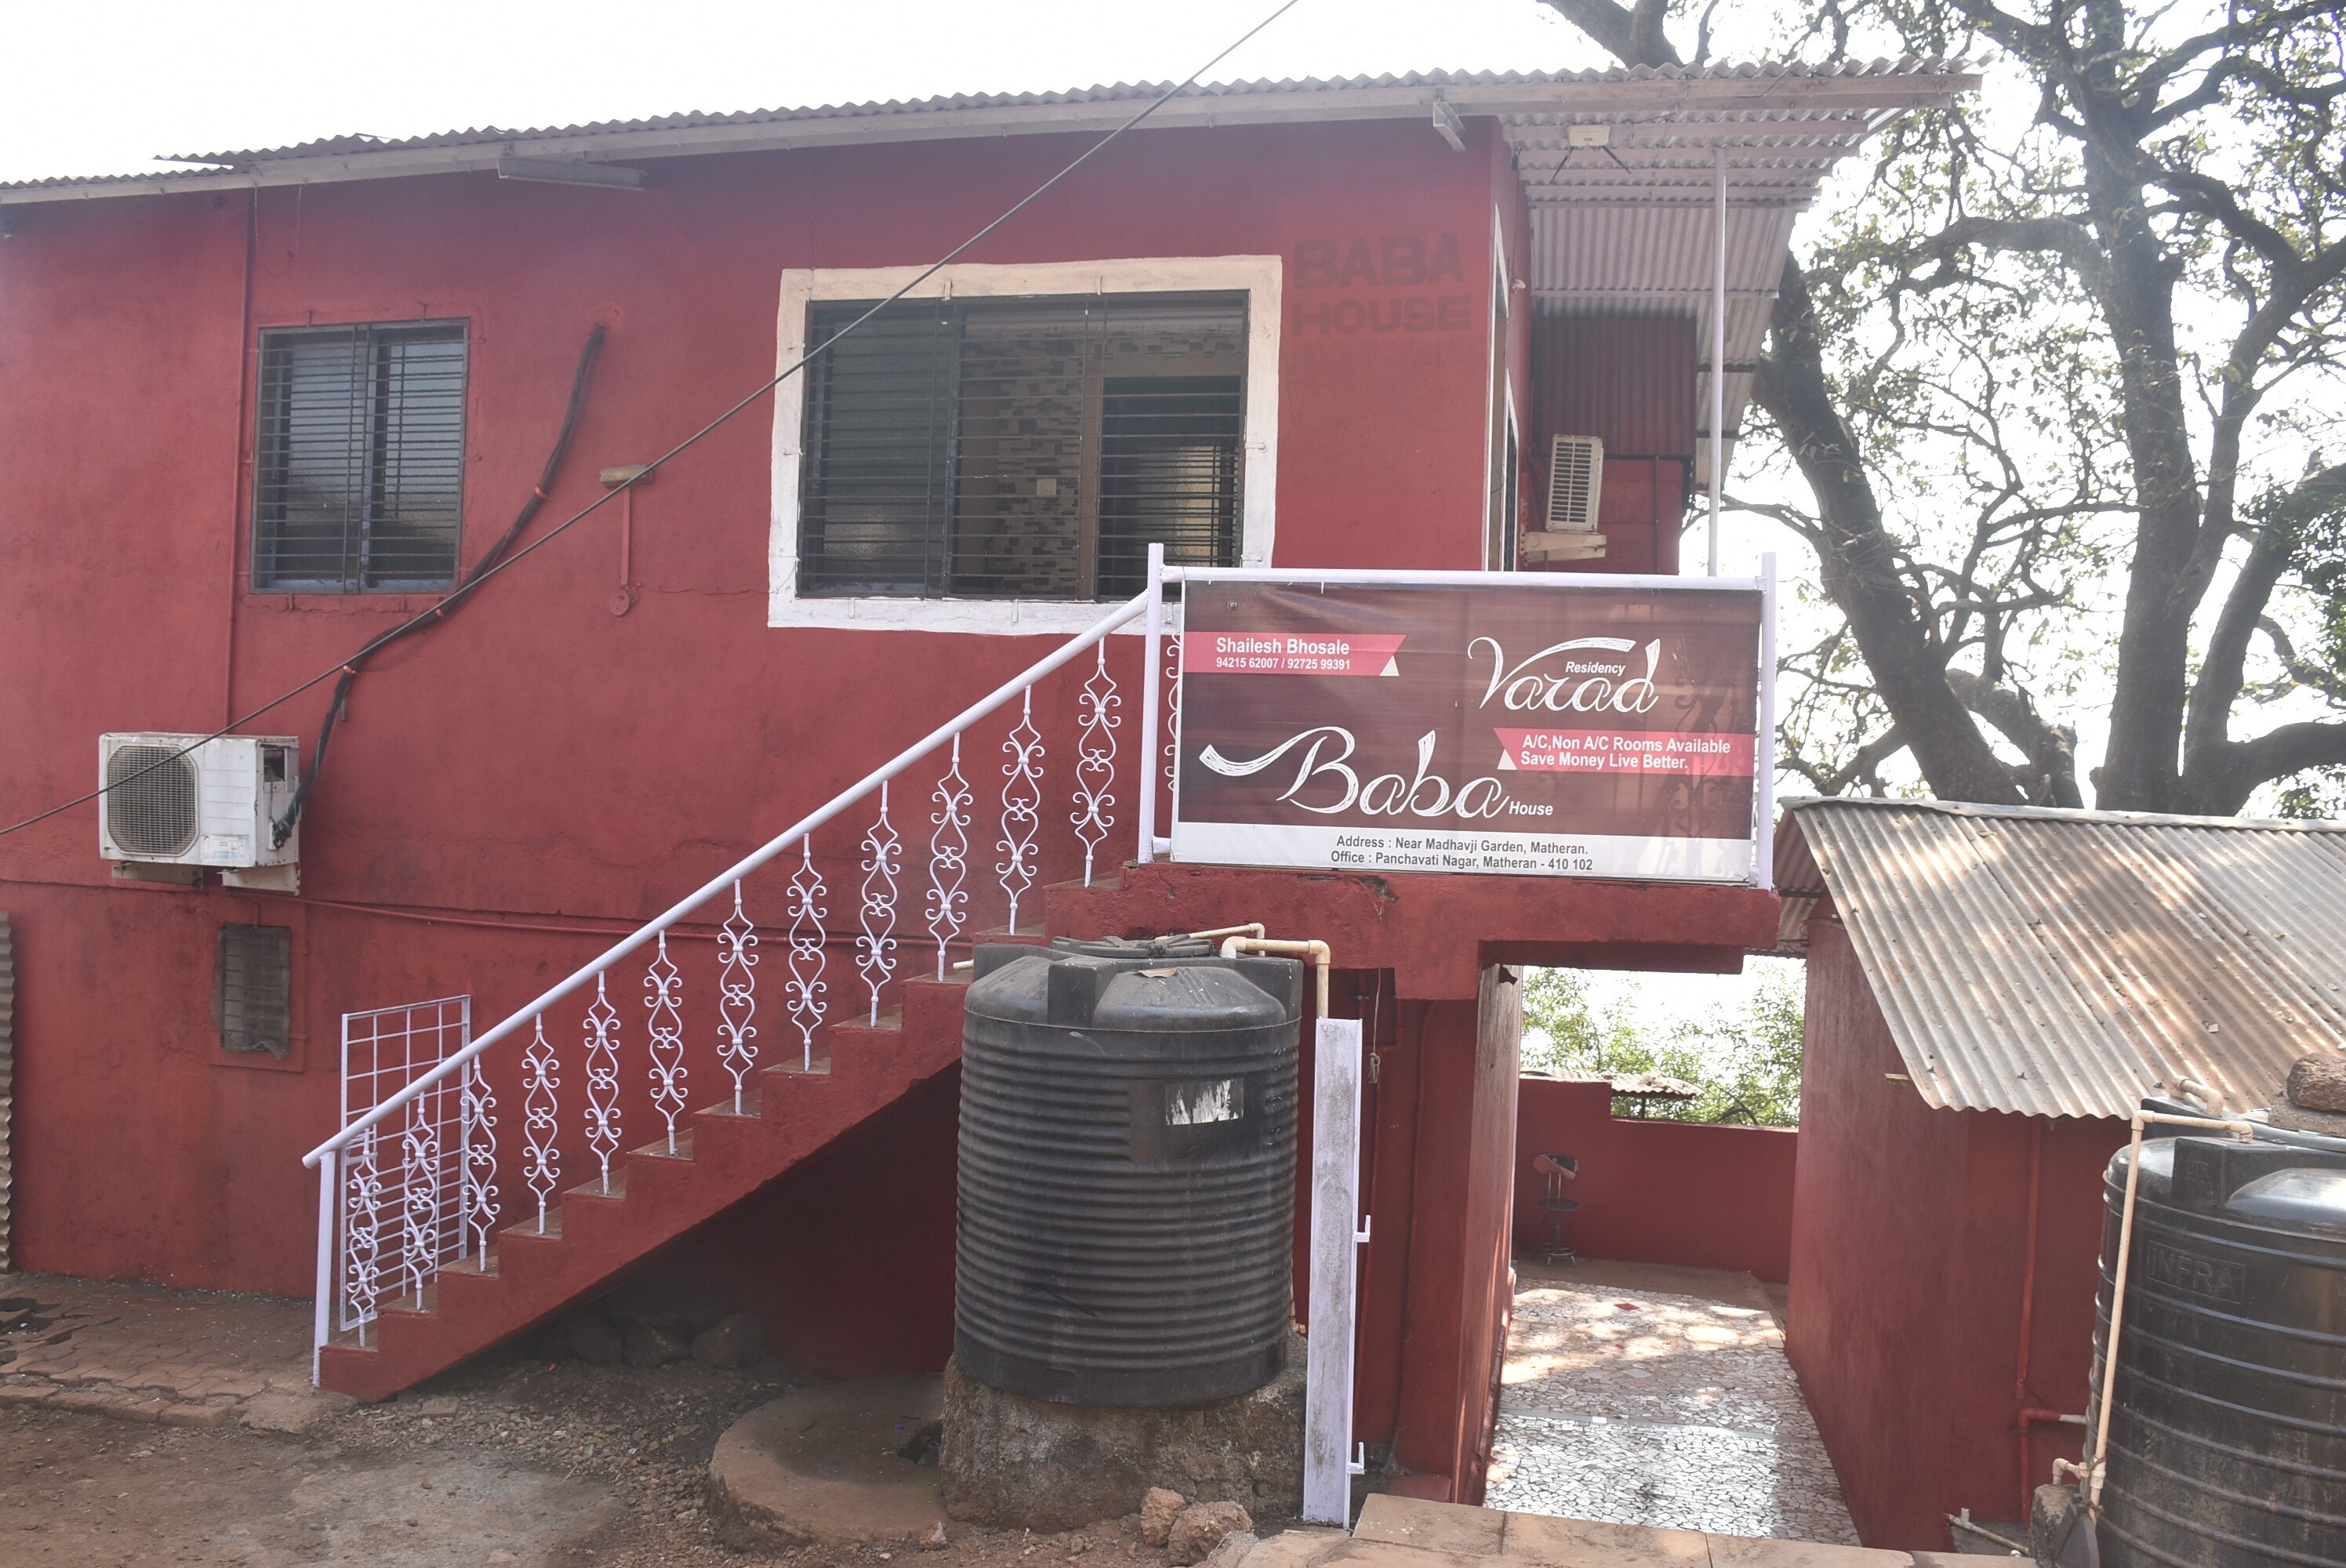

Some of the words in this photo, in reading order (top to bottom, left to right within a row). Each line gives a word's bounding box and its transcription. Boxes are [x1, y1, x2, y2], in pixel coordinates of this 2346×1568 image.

[1293, 233, 1463, 289] BABA
[1291, 296, 1472, 336] HOUSE
[1216, 637, 1282, 654] Shailesh
[1287, 638, 1349, 655] Bhosale
[1216, 657, 1246, 668] 94215
[1249, 658, 1278, 669] 62007
[1287, 659, 1318, 670] 92725
[1320, 659, 1350, 670] 99391
[1565, 661, 1625, 677] Residency
[1468, 637, 1660, 713] Varad
[1522, 735, 1580, 751] A/C,Non
[1583, 735, 1609, 750] A/C
[1614, 737, 1663, 752] Rooms
[1666, 738, 1730, 753] Available
[1520, 751, 1555, 766] Save
[1559, 753, 1605, 771] Money
[1609, 753, 1639, 768] Live
[1643, 754, 1687, 769] Better.
[1199, 726, 1510, 818] Baba
[1509, 800, 1553, 816] House
[1336, 835, 1385, 848] Address
[1396, 837, 1422, 849] Near
[1425, 838, 1477, 853] Madhavji
[1481, 840, 1527, 854] Garden,
[1531, 842, 1589, 855] Matheran.
[1331, 851, 1364, 863] Office
[1375, 852, 1439, 866] Panchavati
[1443, 854, 1480, 869] Nagar,
[1483, 856, 1537, 869] Matheran
[1548, 858, 1569, 869] 410
[1573, 859, 1592, 870] 102
